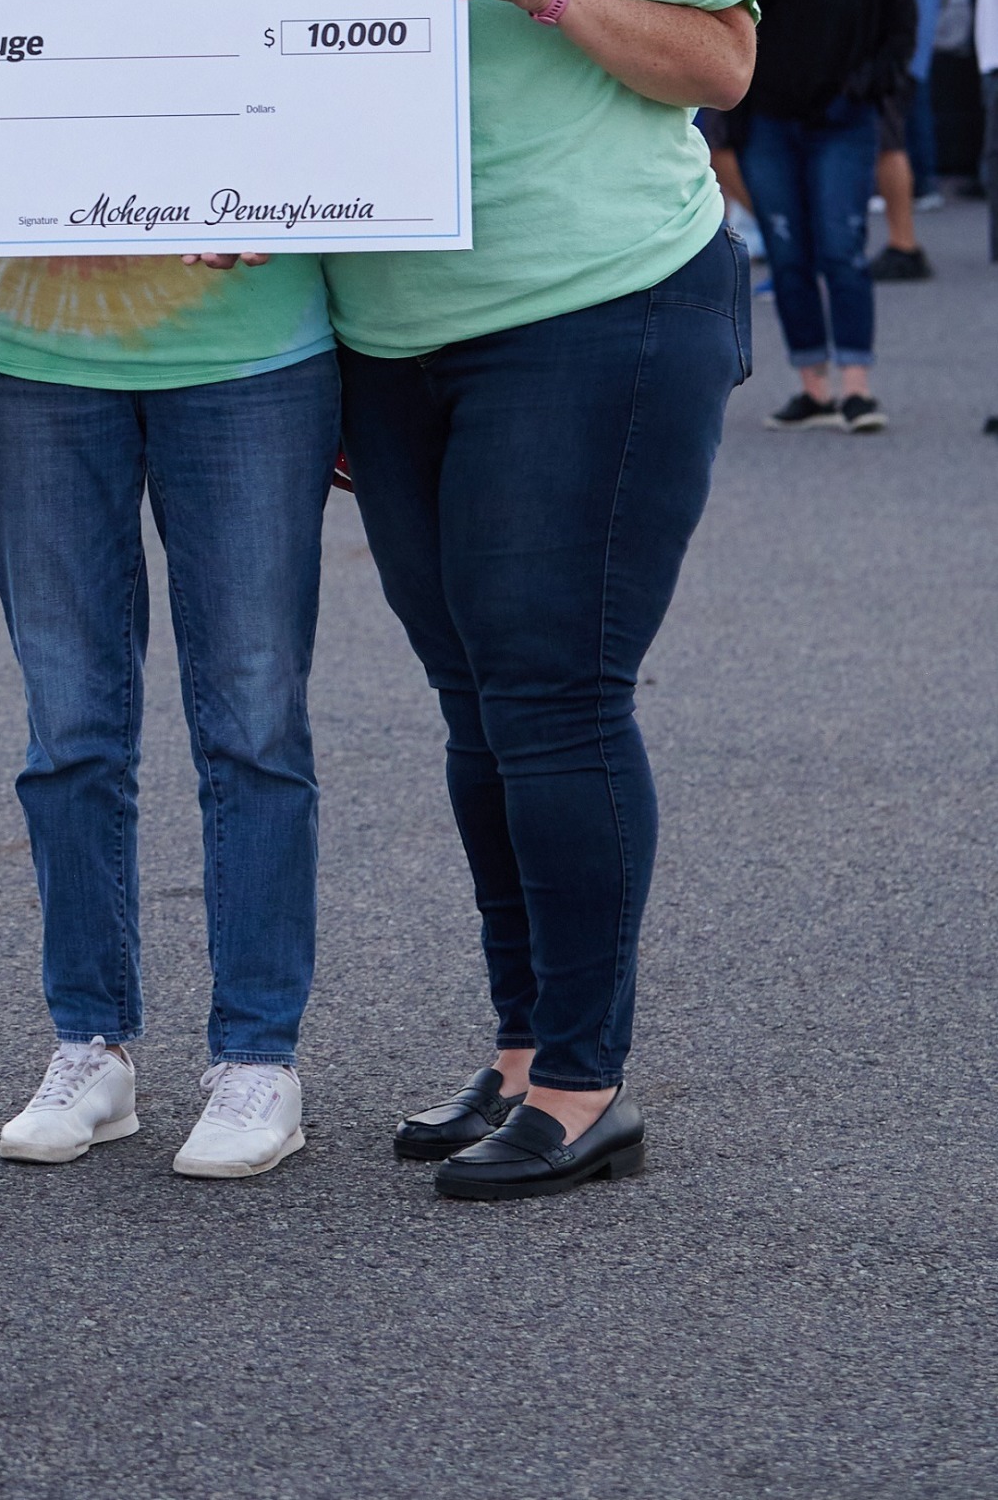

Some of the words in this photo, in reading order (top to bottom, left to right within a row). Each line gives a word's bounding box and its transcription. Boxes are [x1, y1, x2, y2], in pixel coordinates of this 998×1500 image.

[263, 27, 275, 49] $
[306, 21, 408, 51] 10,000
[246, 104, 276, 115] Dollars
[69, 192, 190, 231] Mohegan
[204, 188, 375, 229] Pennsylvania
[18, 215, 59, 227] Signature
